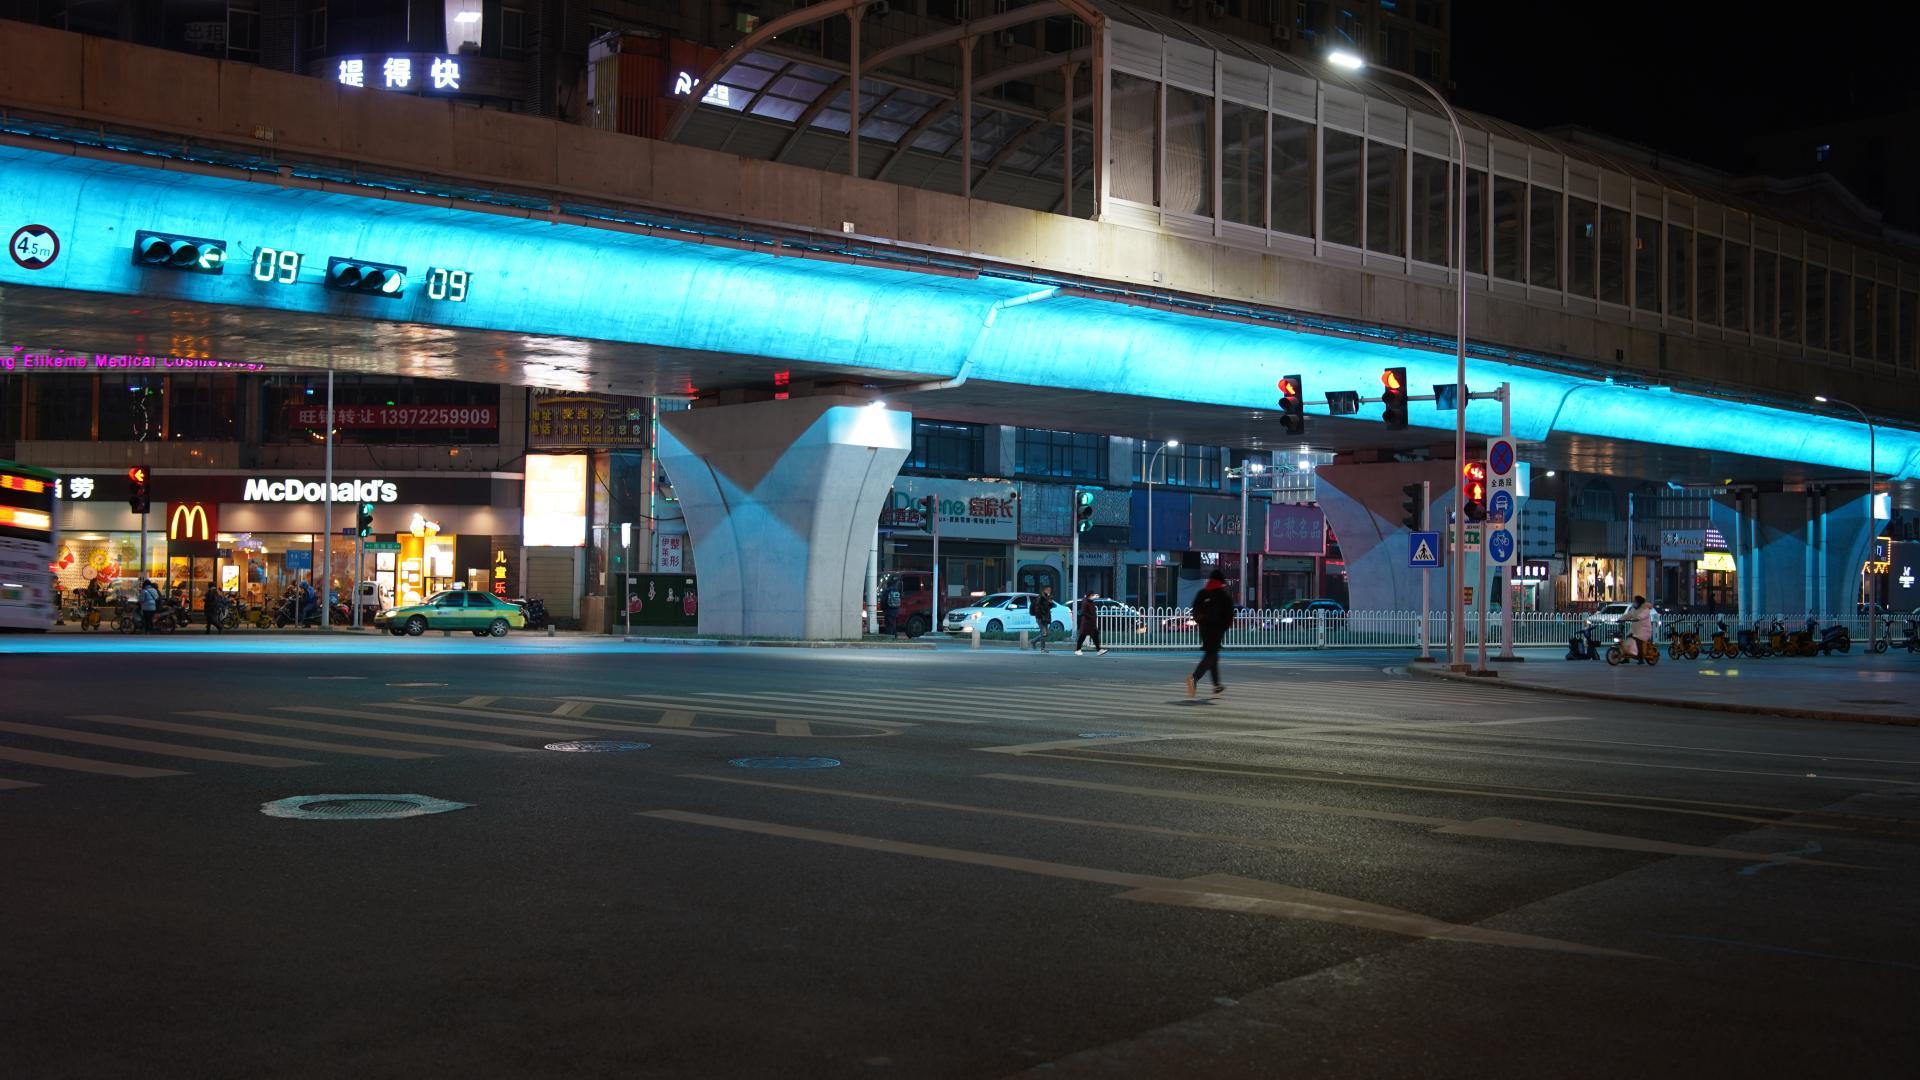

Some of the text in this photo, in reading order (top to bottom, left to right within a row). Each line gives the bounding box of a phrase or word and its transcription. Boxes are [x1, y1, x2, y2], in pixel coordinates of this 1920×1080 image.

[255, 247, 298, 284] 09
[428, 268, 467, 302] 09
[95, 354, 157, 368] Medical
[380, 409, 490, 425] 13972259909
[243, 479, 398, 502] McDonald's
[1491, 478, 1512, 488] 全路段
[1272, 516, 1321, 541] 巴黎名品
